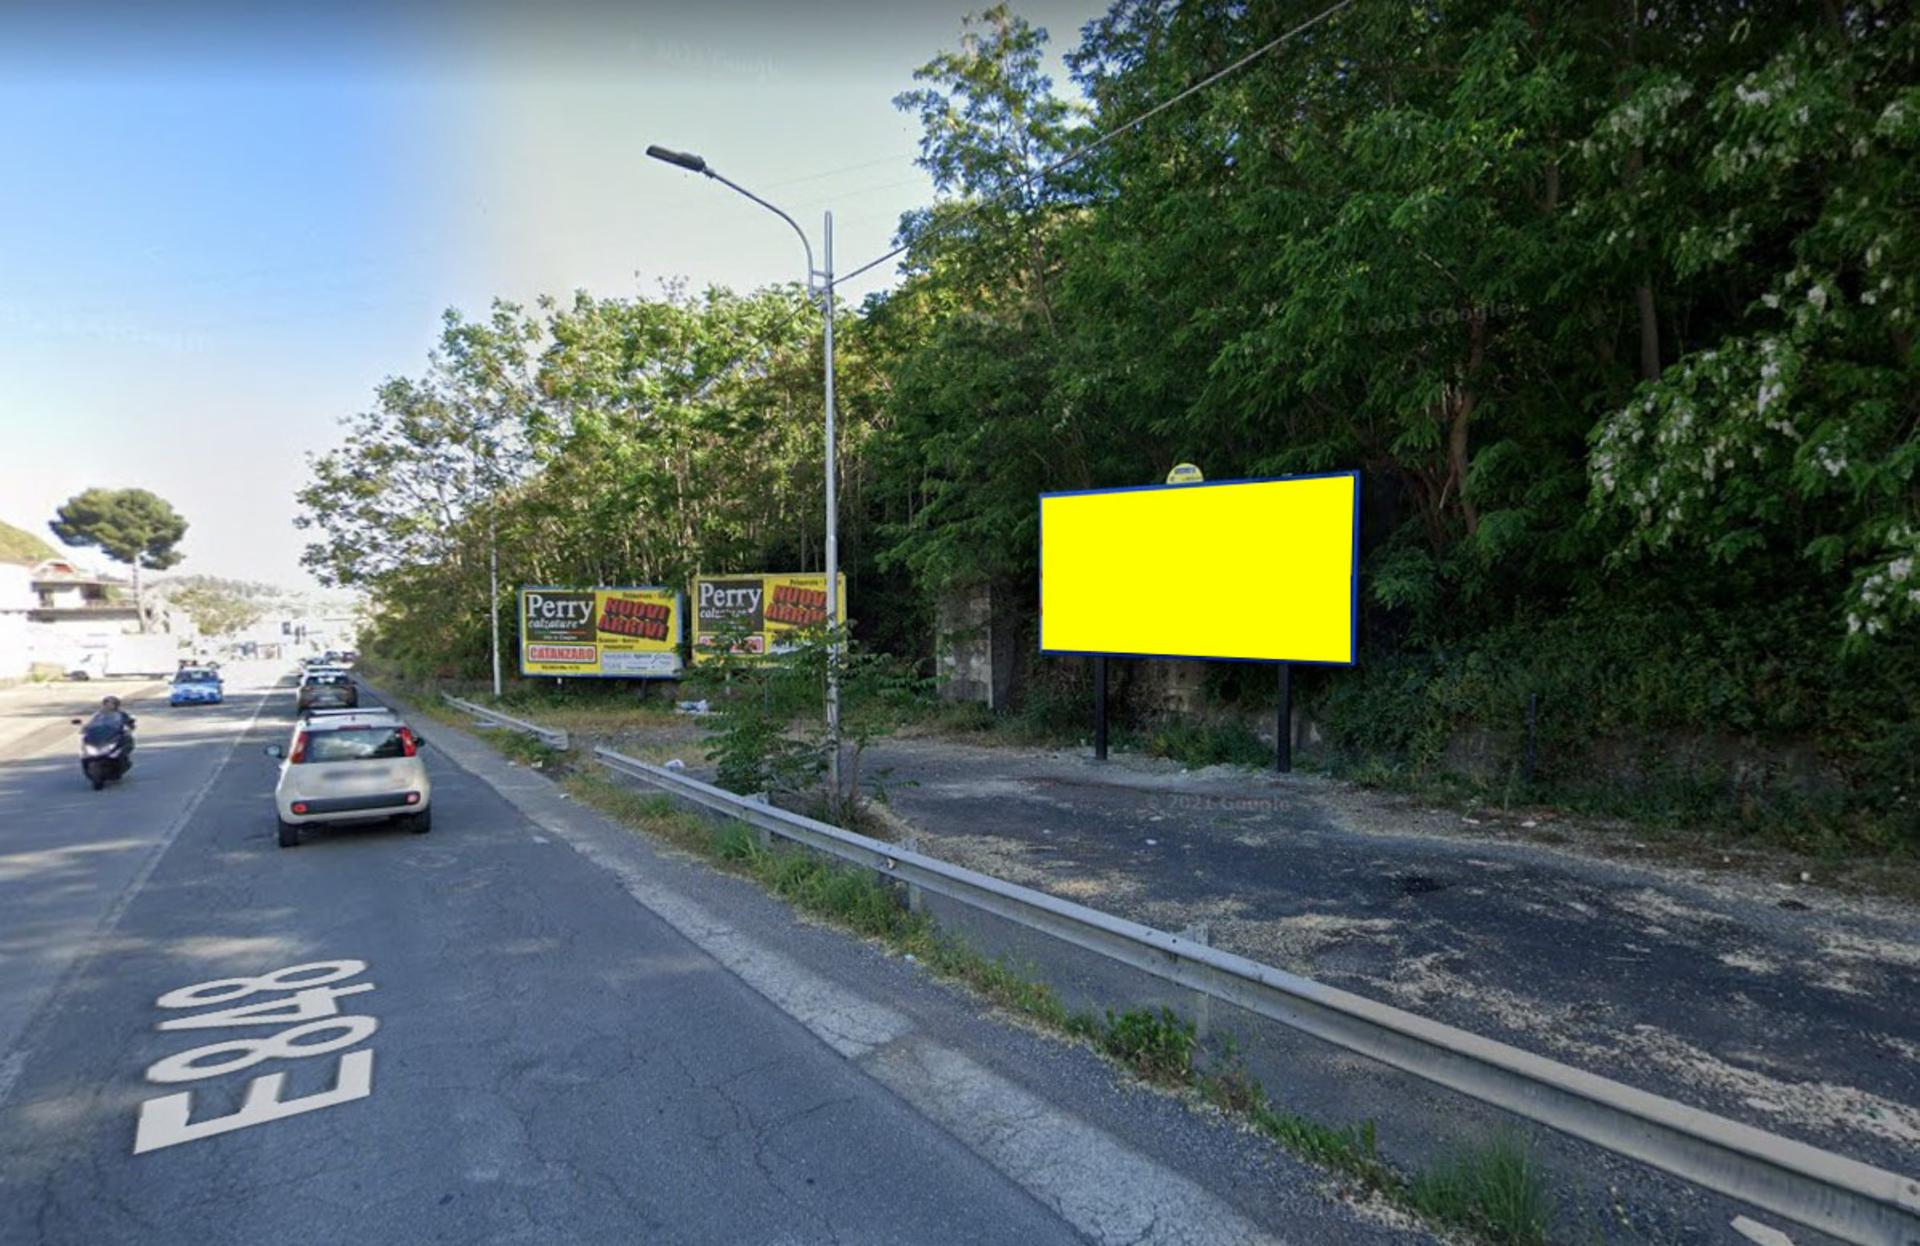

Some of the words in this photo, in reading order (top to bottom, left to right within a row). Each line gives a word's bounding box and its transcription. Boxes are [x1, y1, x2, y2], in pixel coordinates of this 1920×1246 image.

[604, 597, 668, 621] NUOVI
[699, 583, 762, 613] Perry
[773, 584, 827, 609] NUOV
[527, 594, 594, 625] Perry
[764, 602, 827, 628] ARRIV
[528, 618, 579, 630] calzature
[598, 613, 668, 639] ARRIVI
[531, 646, 595, 660] CATANZARO
